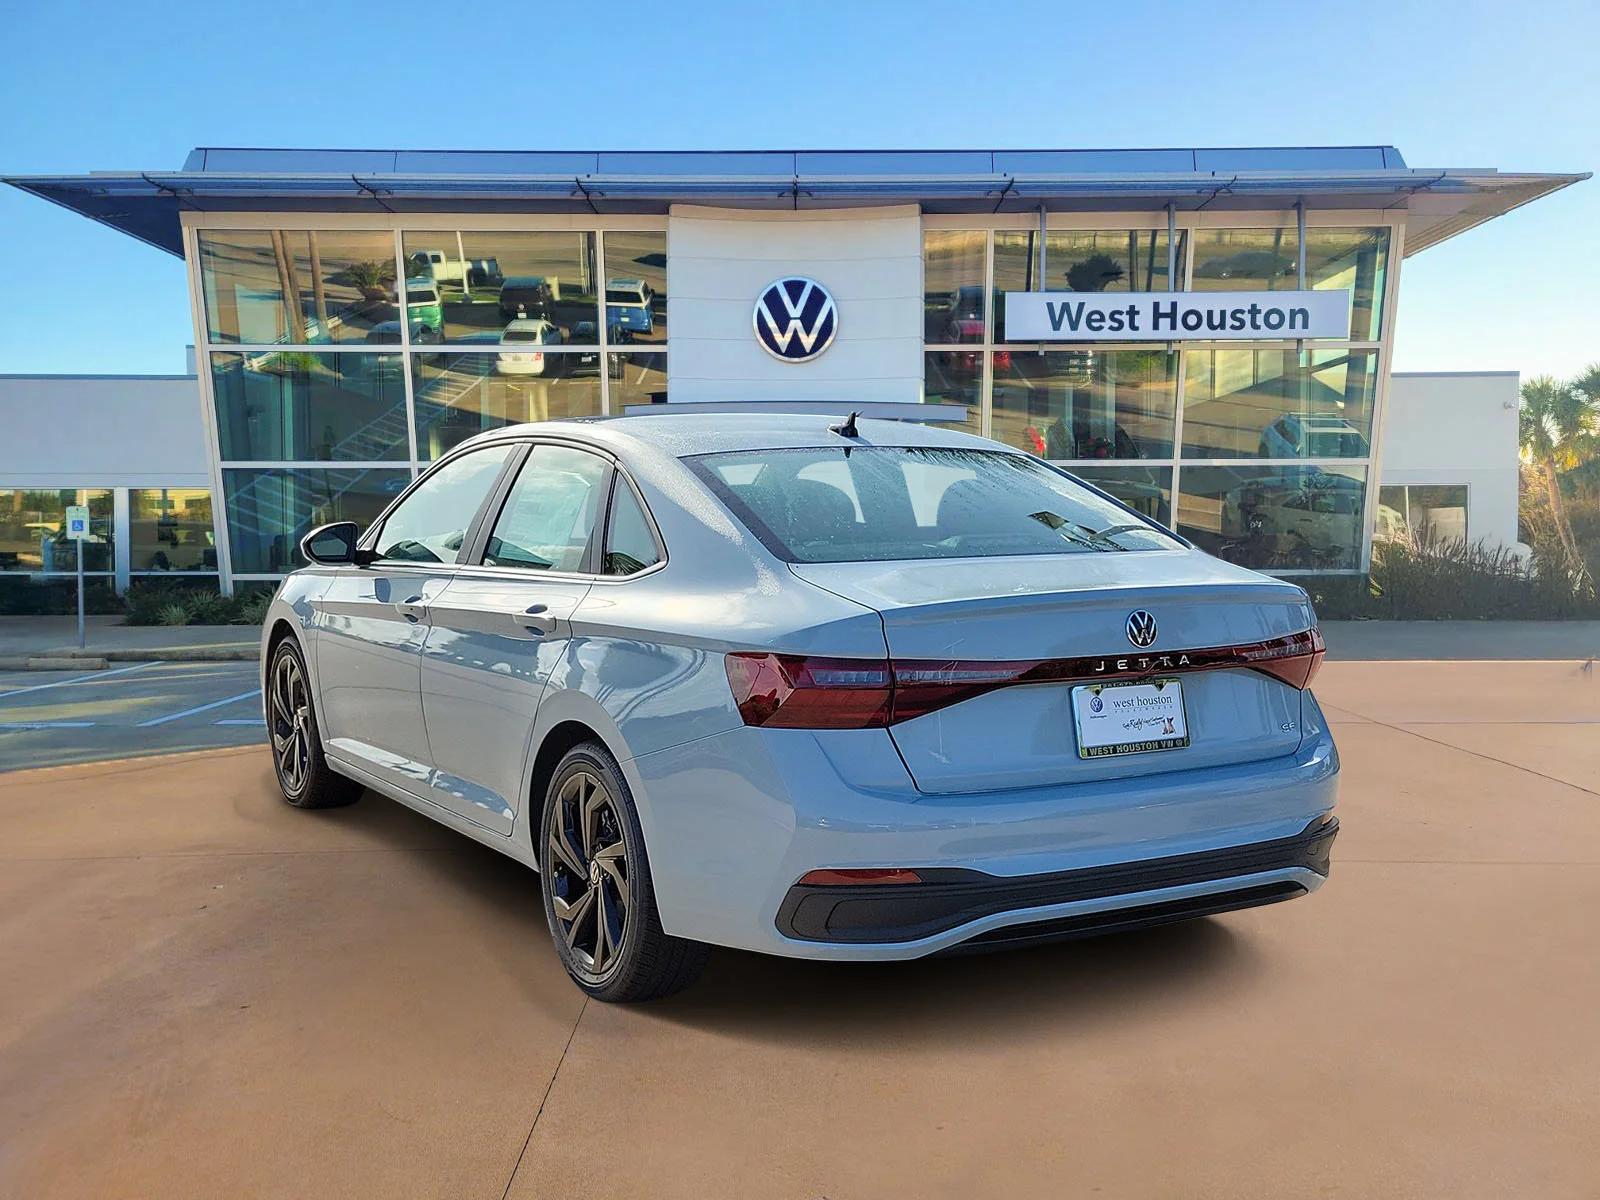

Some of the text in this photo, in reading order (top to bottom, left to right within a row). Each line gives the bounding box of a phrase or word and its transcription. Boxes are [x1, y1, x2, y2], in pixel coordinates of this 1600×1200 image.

[754, 276, 838, 362] VW
[1046, 301, 1310, 332] West Houston
[1126, 609, 1158, 648] VW
[1095, 654, 1190, 672] JETTA
[1113, 696, 1172, 708] west houston
[1089, 739, 1174, 756] WEST HOUSTON VW
